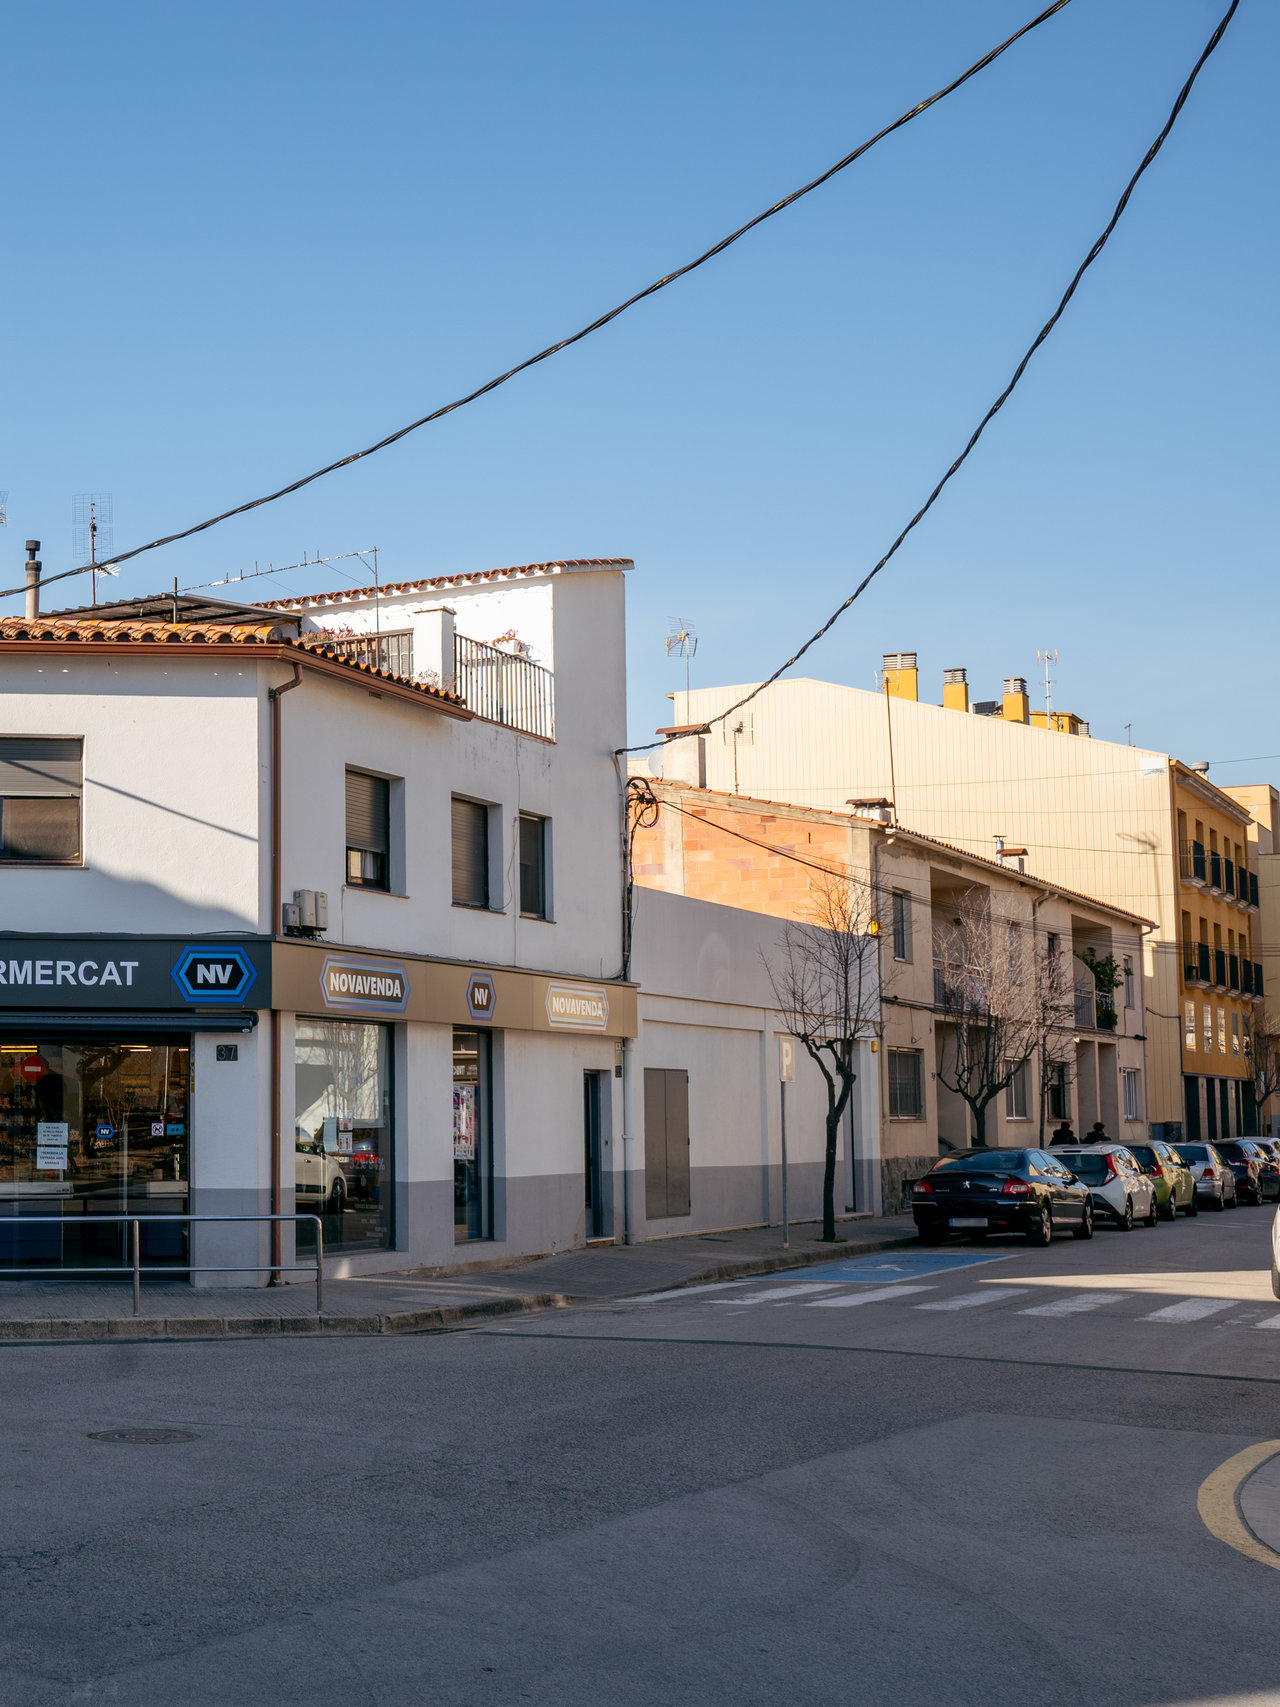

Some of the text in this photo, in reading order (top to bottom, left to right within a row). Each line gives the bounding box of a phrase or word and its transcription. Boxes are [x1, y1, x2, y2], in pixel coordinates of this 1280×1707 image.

[196, 963, 234, 984] NV
[329, 972, 402, 998] NOVAVENDA
[474, 987, 489, 1006] NV
[552, 996, 604, 1018] NOVAVENDA
[217, 1045, 237, 1060] 37
[782, 1042, 792, 1077] P
